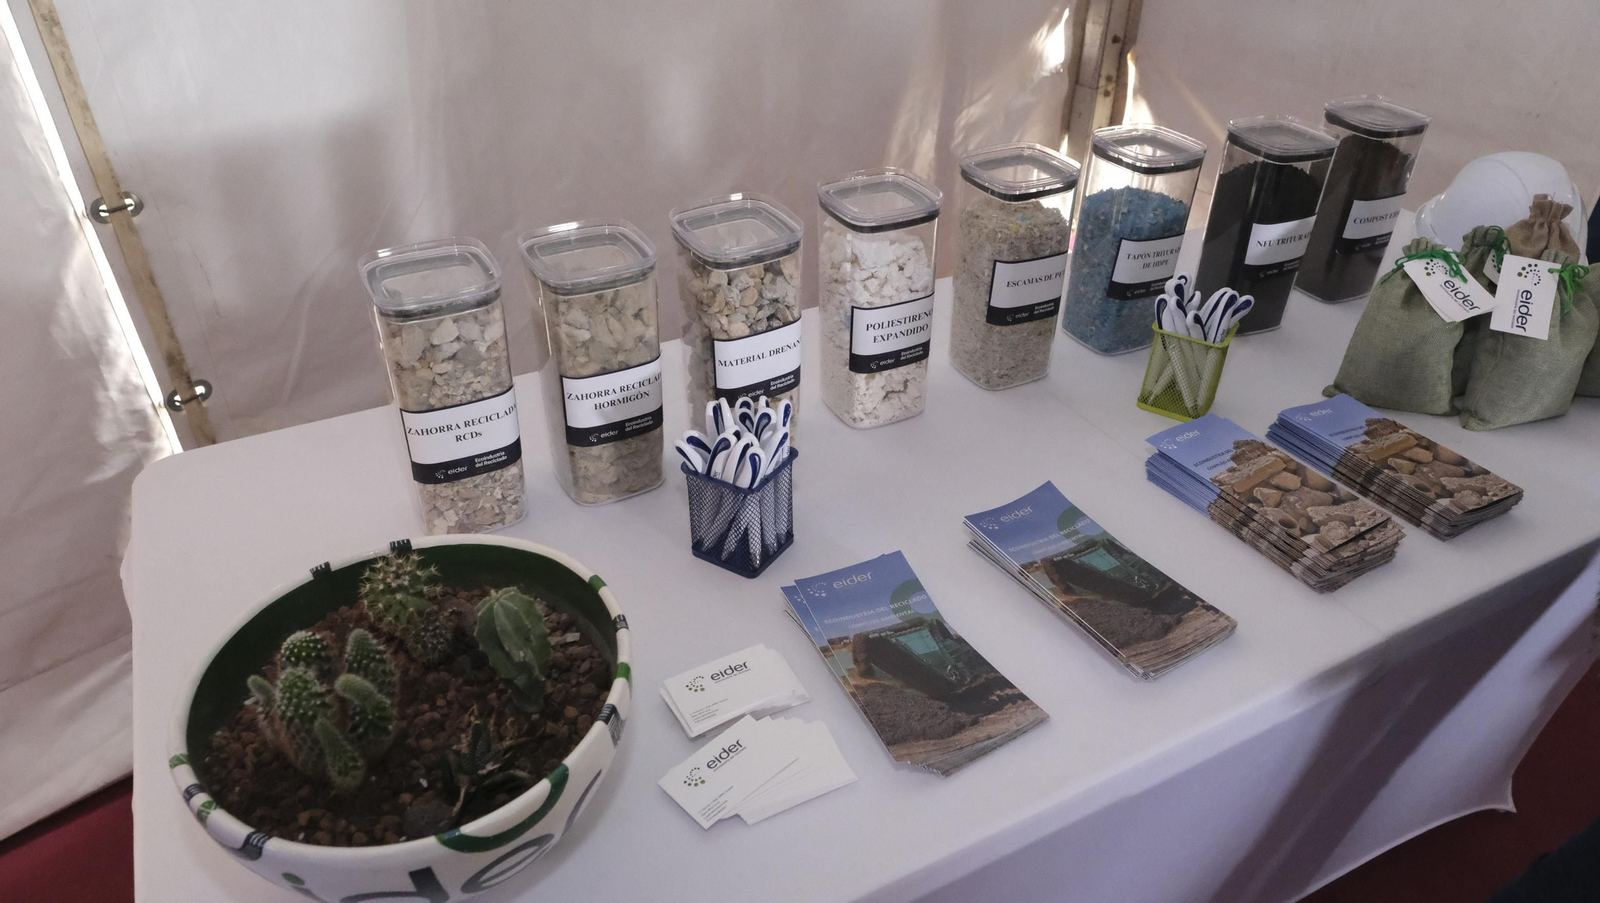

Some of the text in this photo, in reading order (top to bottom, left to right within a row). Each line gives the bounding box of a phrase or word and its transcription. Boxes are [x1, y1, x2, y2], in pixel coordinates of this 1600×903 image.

[1006, 275, 1043, 288] ESCAMAS
[1044, 273, 1054, 282] DE
[1444, 280, 1480, 311] eider
[1515, 289, 1534, 332] eider
[873, 323, 929, 343] EXPANDIDO
[718, 352, 767, 368] MATERIAL
[567, 388, 617, 401] ZAHORRA
[594, 390, 650, 411] HORMIGÓN
[407, 422, 461, 437] ZAHORRA
[455, 431, 482, 442] RCDs
[1175, 429, 1200, 442] eider
[1000, 505, 1034, 523] eider
[833, 571, 872, 589] eider
[824, 609, 876, 624] ECOINDUSTRIA
[890, 594, 928, 609] RECICLADO
[710, 661, 748, 681] eider
[706, 739, 743, 769] eider
